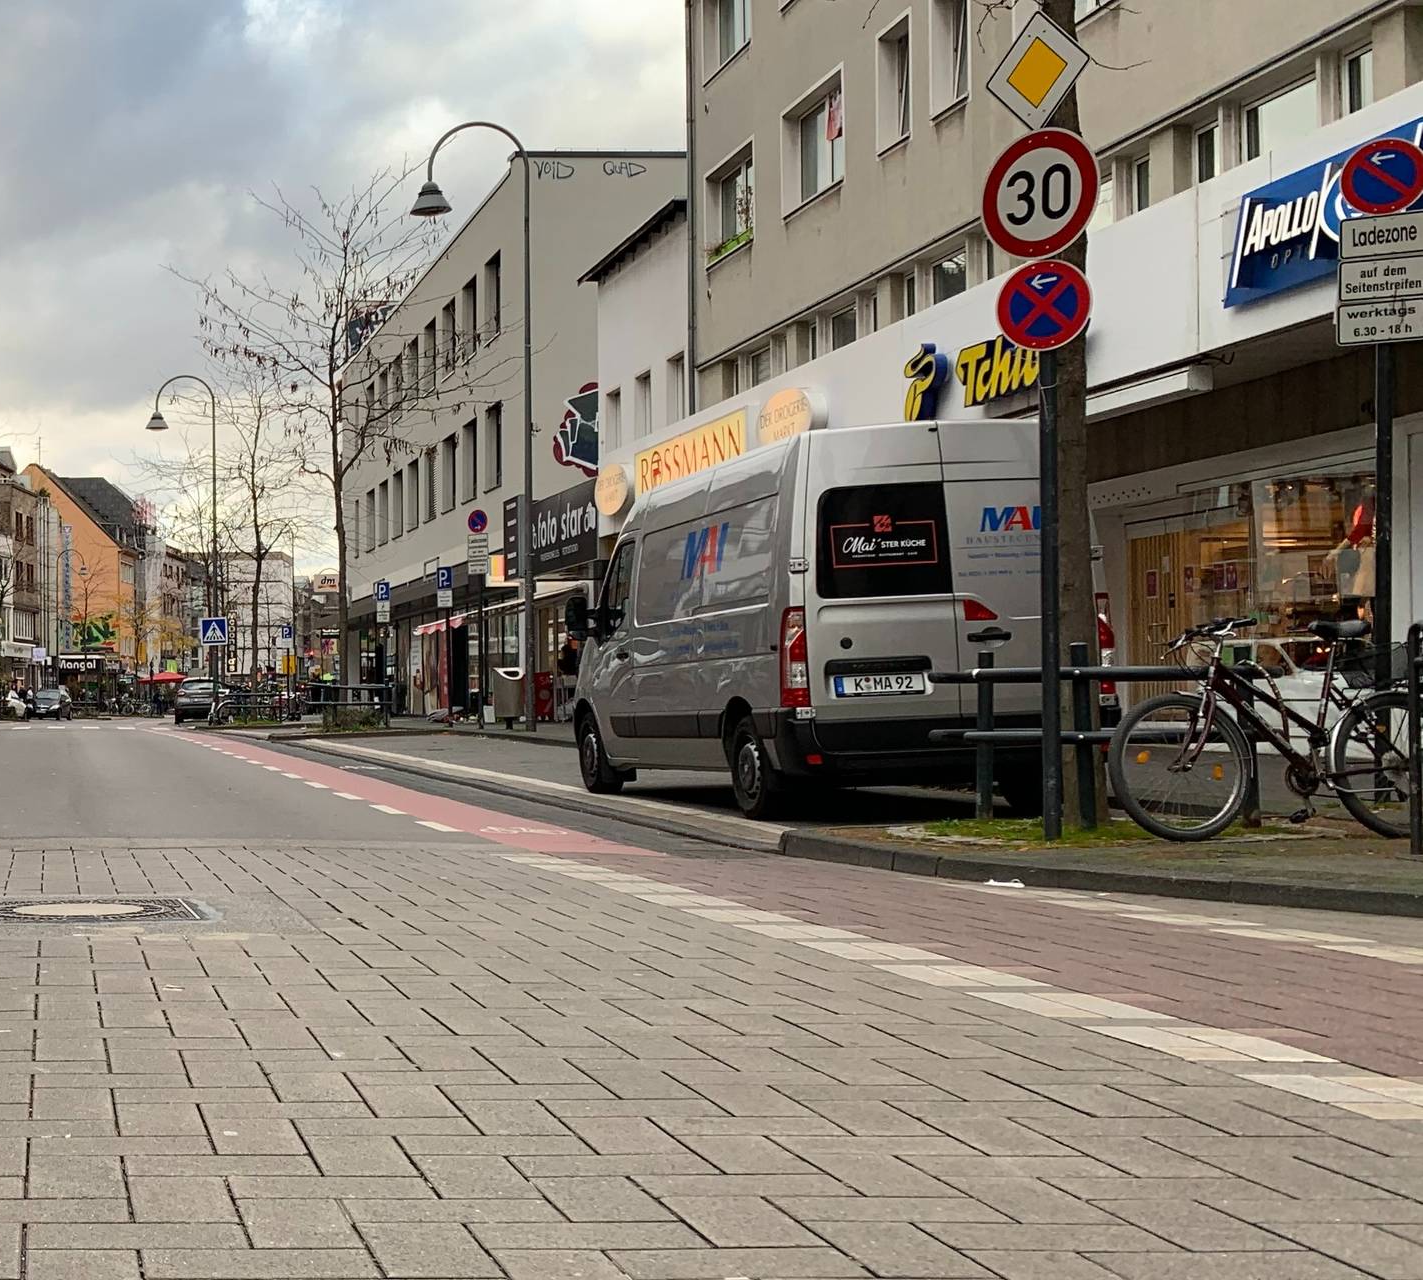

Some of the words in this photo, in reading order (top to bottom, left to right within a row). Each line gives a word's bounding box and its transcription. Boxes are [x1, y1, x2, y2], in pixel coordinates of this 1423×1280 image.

[1006, 162, 1071, 226] 30
[1243, 191, 1319, 257] APOLLO
[1352, 225, 1418, 247] Ladezone
[1360, 266, 1378, 279] auf
[1383, 265, 1407, 277] dem
[1345, 278, 1422, 294] Seitenstreifen
[1346, 305, 1416, 319] werktags
[1353, 326, 1377, 337] 6.30
[1388, 325, 1401, 334] 18
[1405, 323, 1412, 333] h
[957, 335, 1040, 407] Tchib
[900, 539, 926, 547] KÜCHE
[320, 576, 335, 585] dm
[439, 569, 448, 587] P
[378, 584, 386, 599] P
[854, 678, 864, 692] K
[873, 676, 893, 690] MA
[895, 676, 914, 689] 92
